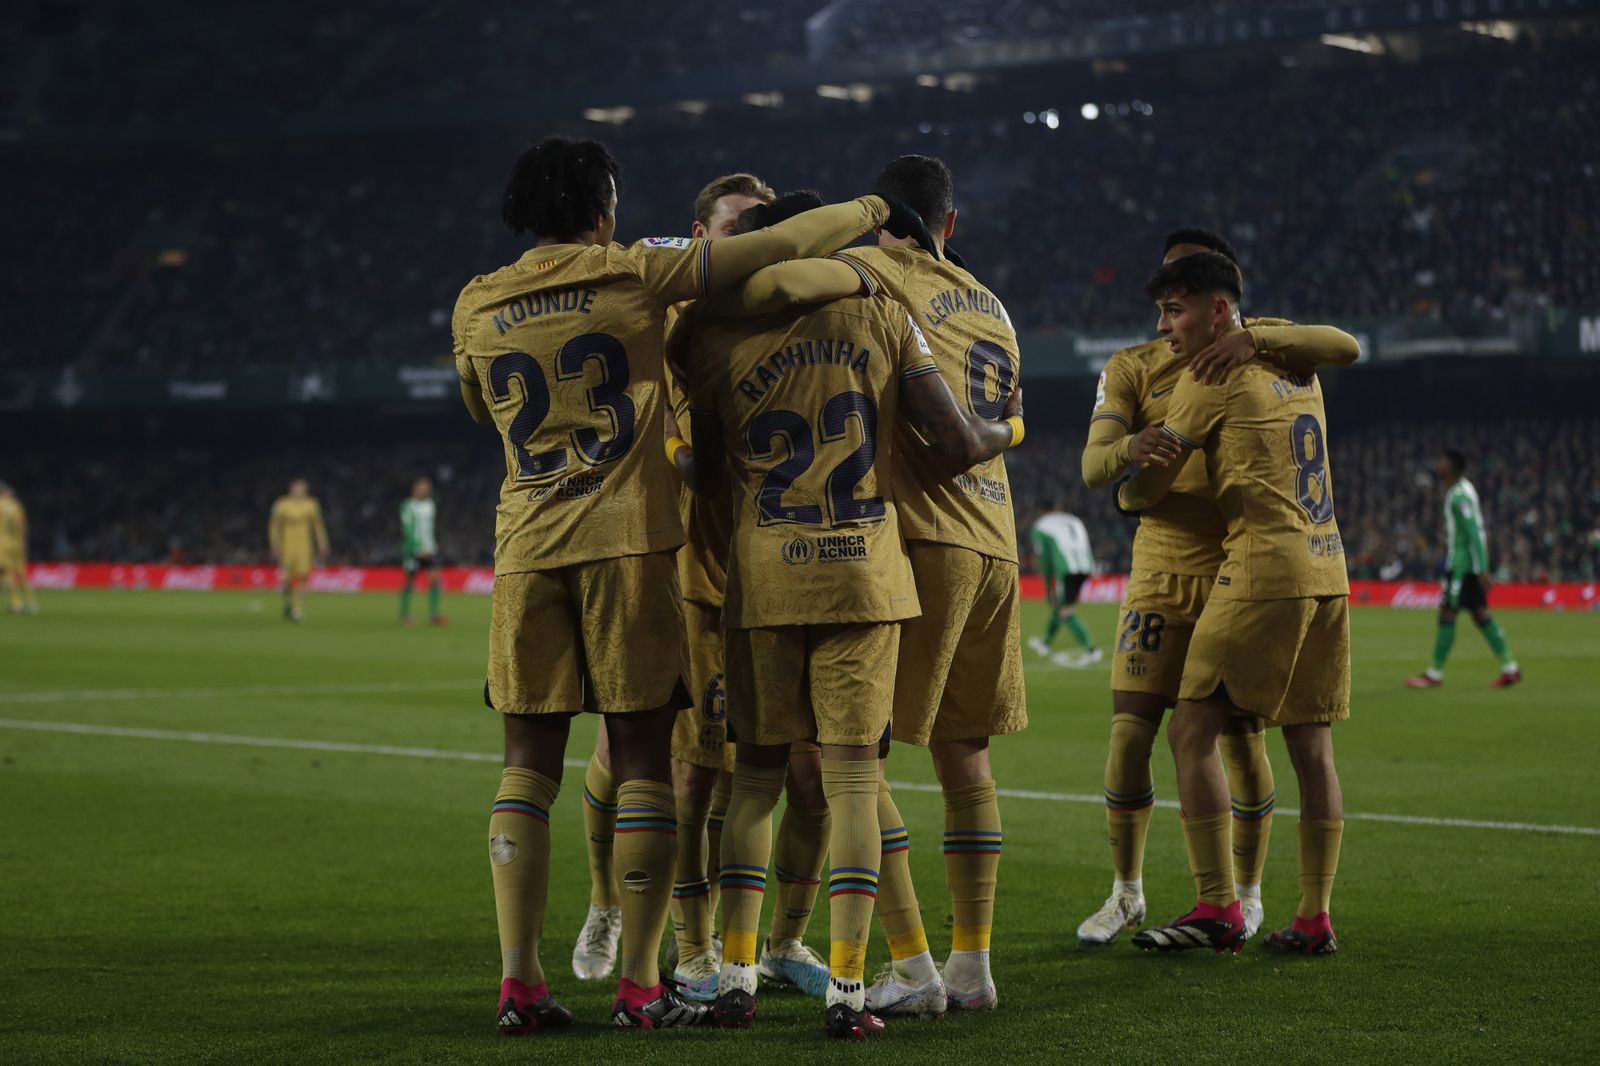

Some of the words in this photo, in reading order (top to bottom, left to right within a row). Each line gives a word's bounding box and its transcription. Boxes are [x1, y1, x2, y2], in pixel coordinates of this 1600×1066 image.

[491, 287, 597, 336] KOUNDE
[923, 289, 1004, 330] LEWANDO
[739, 339, 871, 404] RAPHINHA
[486, 332, 635, 482] 23
[745, 391, 886, 528] 22
[1289, 414, 1335, 524] 8
[556, 484, 602, 497] ACNUR
[816, 535, 866, 548] UNHCR
[817, 546, 867, 559] ACNUR
[1119, 610, 1166, 653] 28
[703, 672, 727, 722] 6
